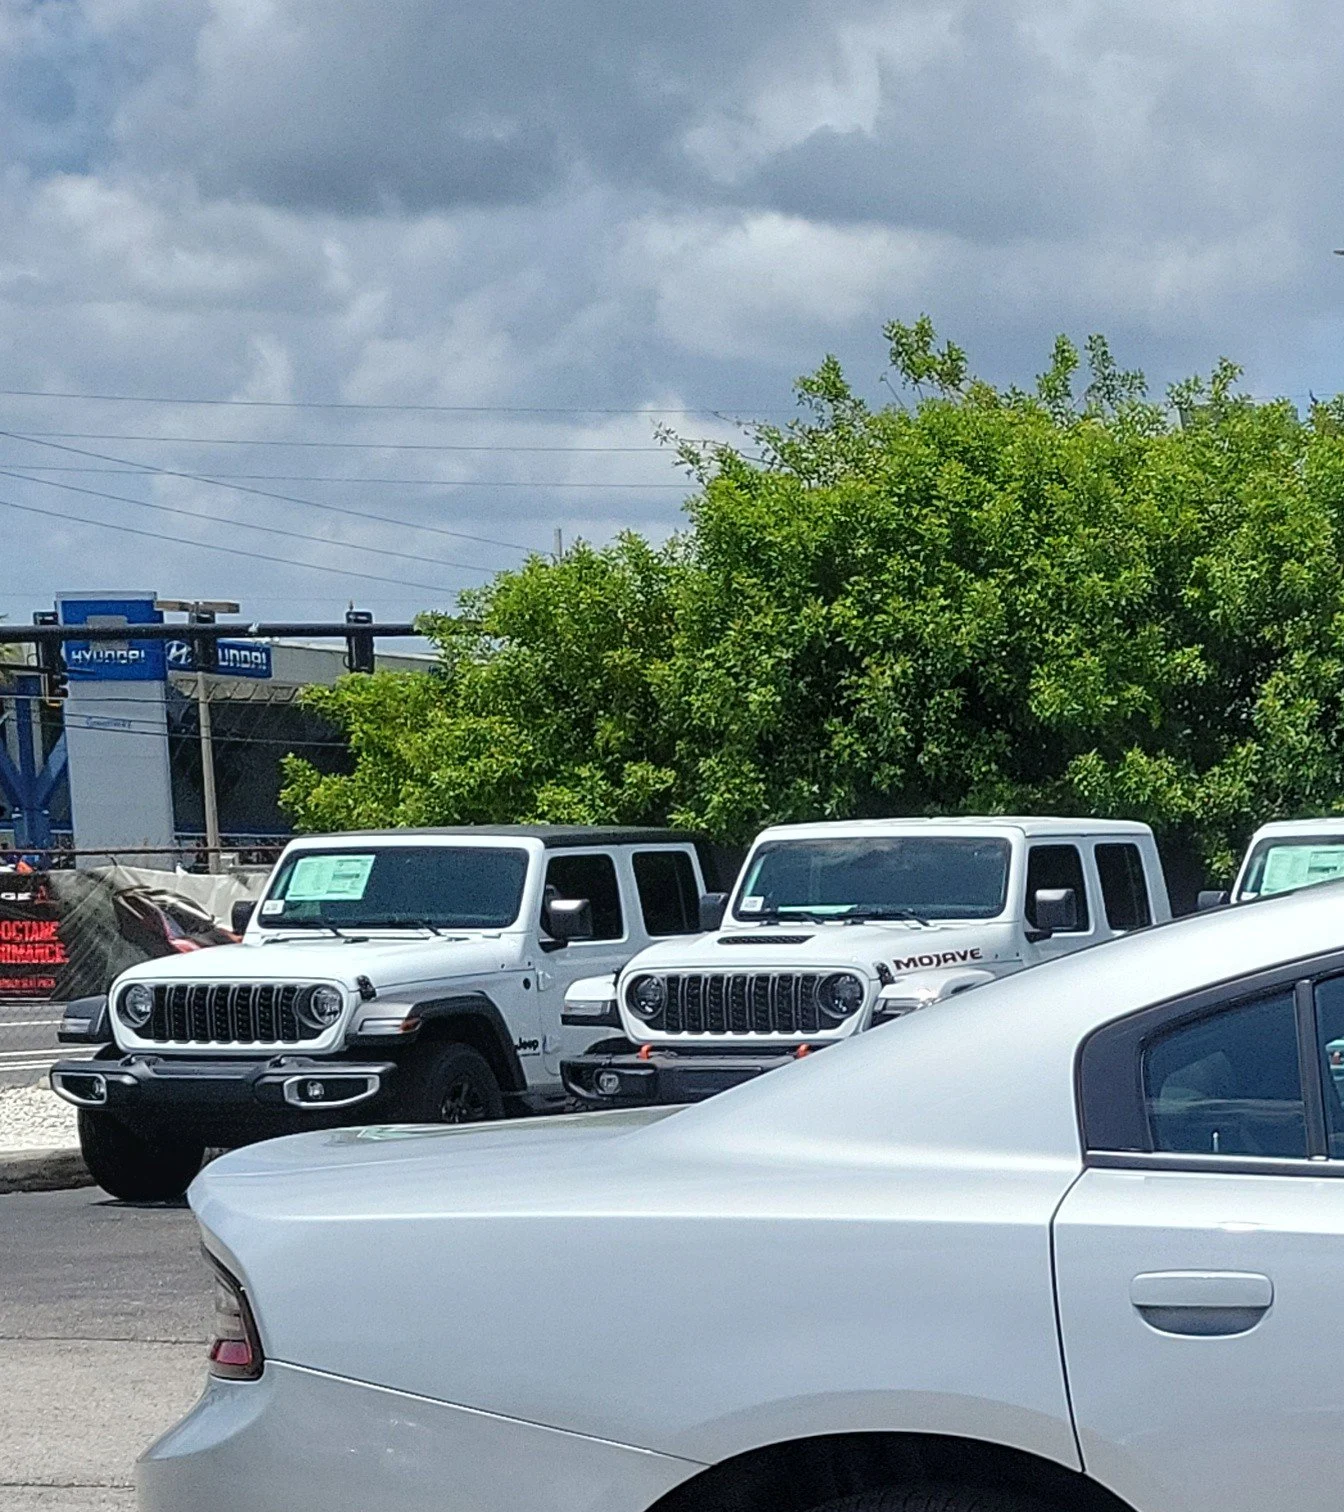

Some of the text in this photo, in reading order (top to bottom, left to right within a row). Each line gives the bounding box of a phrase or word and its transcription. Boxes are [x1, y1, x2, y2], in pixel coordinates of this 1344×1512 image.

[71, 649, 146, 664] HYUNDAI
[217, 647, 267, 670] UNDAI
[893, 947, 984, 971] MOJAVE
